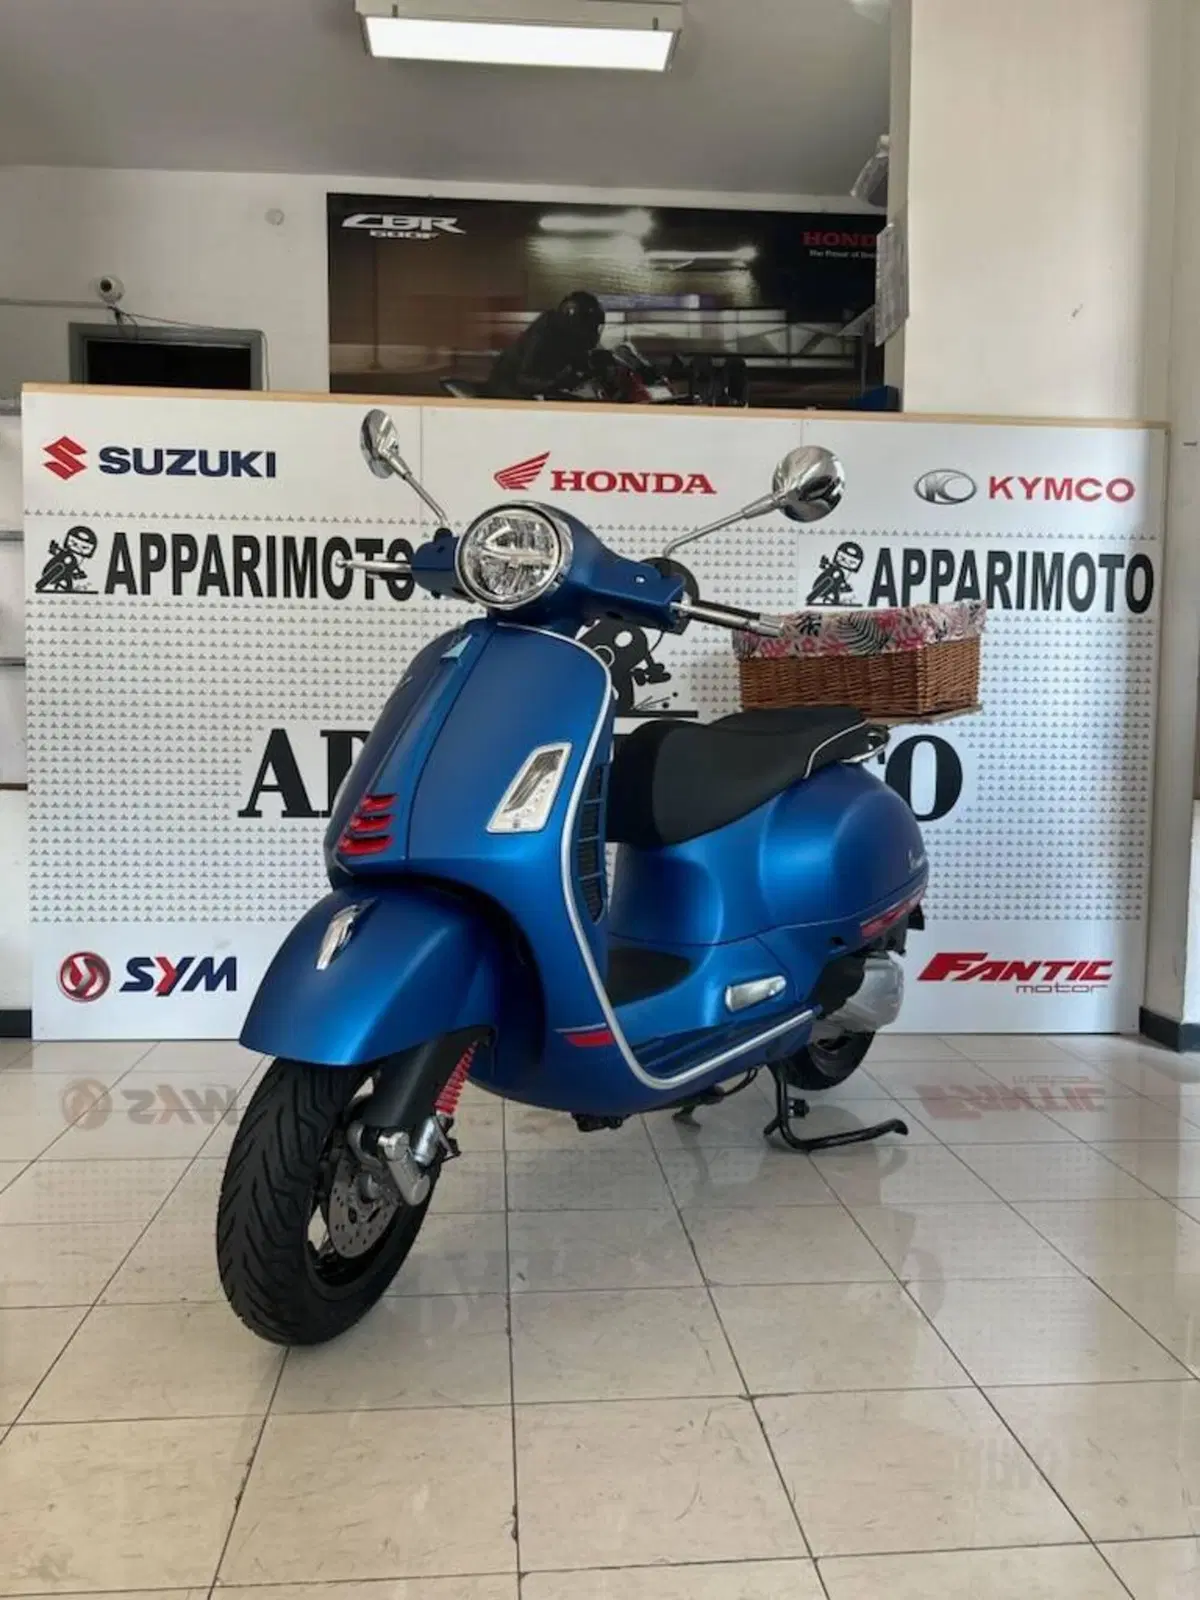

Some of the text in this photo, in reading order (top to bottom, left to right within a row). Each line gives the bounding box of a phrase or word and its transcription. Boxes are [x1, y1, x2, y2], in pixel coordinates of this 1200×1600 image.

[342, 213, 467, 235] CBR
[803, 231, 877, 247] HOND
[98, 446, 277, 478] SUZUKI
[550, 470, 717, 494] HONDA
[989, 476, 1135, 503] KYMCO
[105, 532, 415, 601] APPARIMOTO
[868, 547, 1154, 614] APPARIMOTO
[119, 956, 238, 997] SYM
[917, 953, 1113, 981] FANTIC
[1016, 982, 1109, 994] motor
